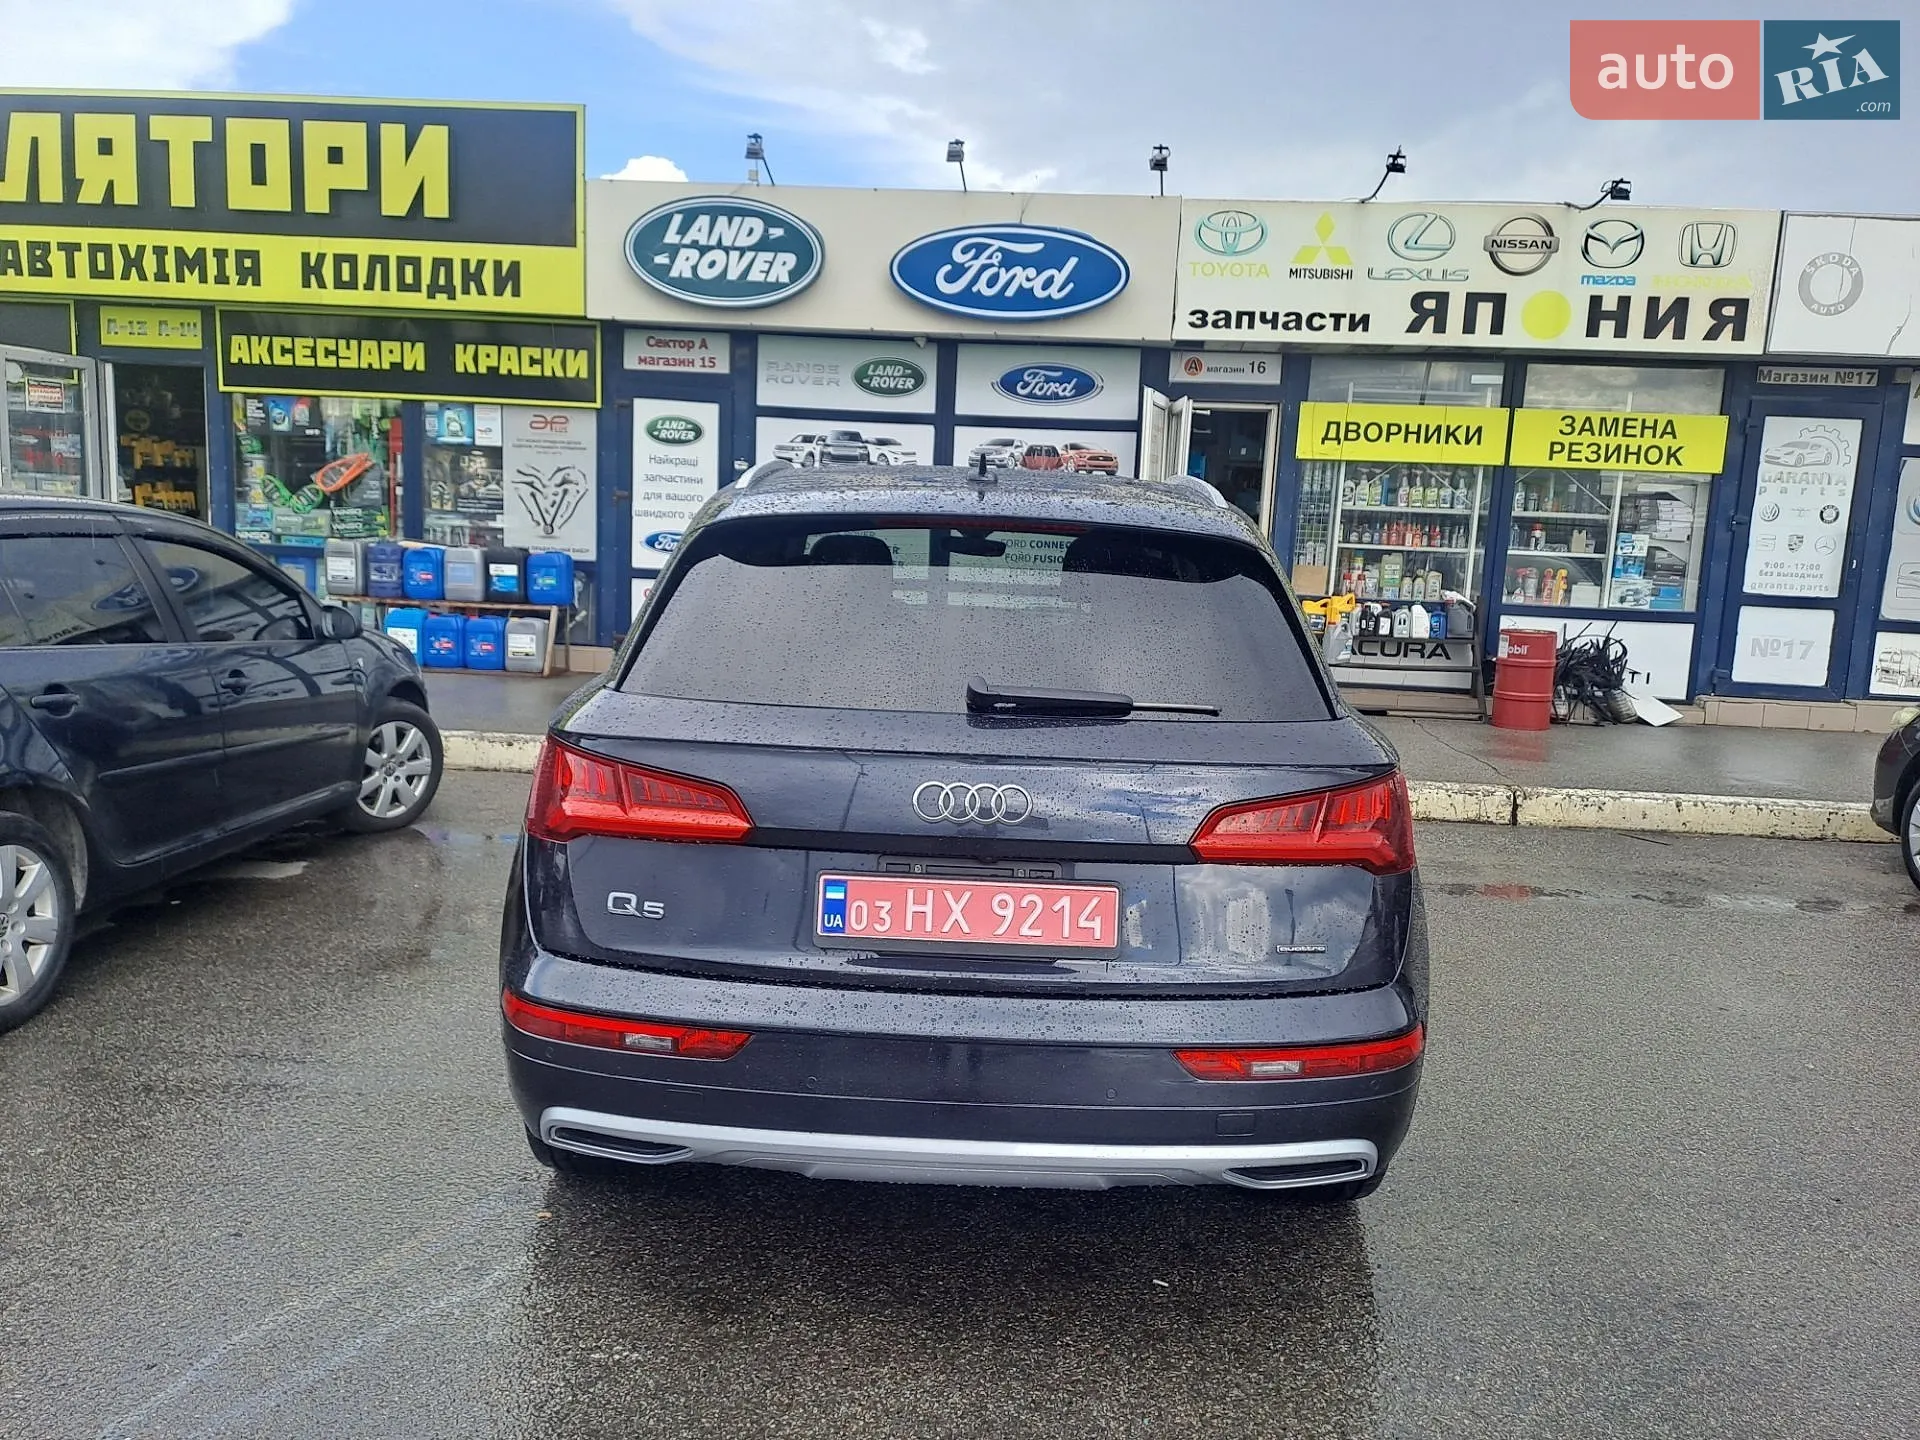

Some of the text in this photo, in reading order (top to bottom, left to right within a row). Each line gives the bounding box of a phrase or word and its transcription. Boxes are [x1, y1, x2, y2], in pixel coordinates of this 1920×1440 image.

[1491, 239, 1552, 250] NISSAN
[0, 240, 521, 300] АВТОХІМІЯ КОЛОДКИ
[935, 237, 1079, 301] Ford
[1189, 262, 1270, 278] TOYOTA
[1288, 267, 1353, 280] MITSUBISHI
[1367, 267, 1469, 281] LEXUS
[1811, 303, 1845, 315] AUTO
[1188, 308, 1371, 334] запчасти
[646, 335, 695, 351] Сектор
[230, 334, 588, 379] АКСЕСУАРИ КРАСКИ
[637, 354, 716, 369] магазин 15
[765, 360, 841, 375] RANGE
[867, 363, 904, 376] LAND
[1206, 366, 1245, 374] магазин
[1249, 361, 1267, 374] 16
[765, 374, 841, 387] ROVER
[868, 376, 916, 389] ROVER
[1016, 368, 1078, 397] Ford
[1758, 369, 1877, 385] Магазин №17
[1321, 420, 1484, 447] ДВОРНИКИ
[1558, 415, 1678, 440] ЗАМЕНА
[648, 453, 699, 468] Найкращі
[1547, 440, 1684, 467] РЕЗИНОК
[643, 473, 704, 485] запчастини
[642, 491, 704, 503] для вашого
[634, 509, 685, 520] швидкого
[1758, 569, 1824, 579] без выходных
[1795, 563, 1821, 571] 17:00
[1351, 641, 1452, 660] CURA
[1508, 644, 1528, 655] obil
[1750, 637, 1816, 661] №17
[607, 891, 665, 919] Q5
[824, 888, 1102, 941] UA 03 HX 9214
